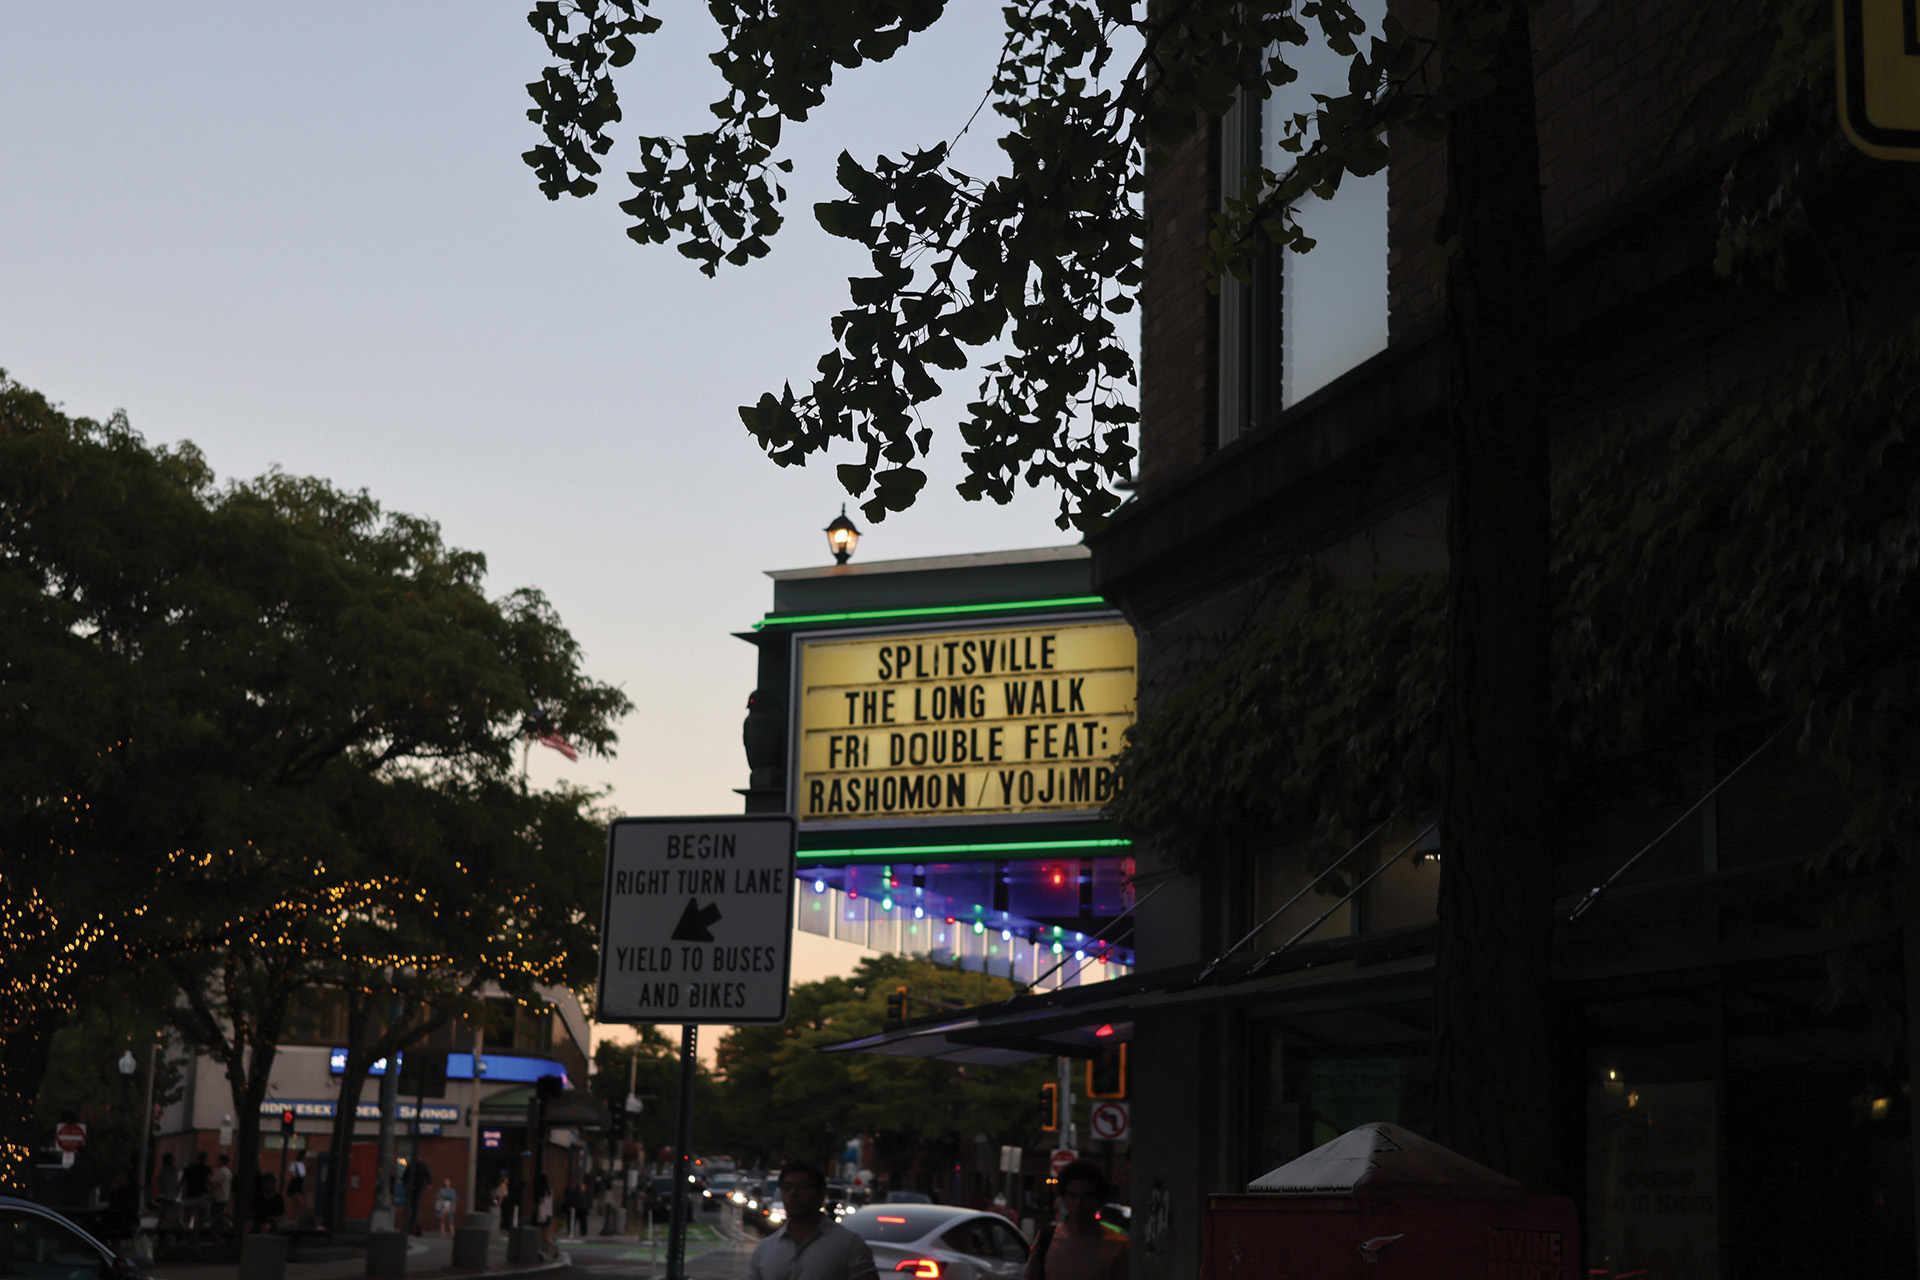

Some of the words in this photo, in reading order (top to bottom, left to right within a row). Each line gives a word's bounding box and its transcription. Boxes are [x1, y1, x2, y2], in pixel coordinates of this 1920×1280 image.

[878, 635, 1056, 680] SPLITSVILLE
[845, 690, 895, 724] THE
[915, 684, 986, 721] LONG
[1004, 677, 1086, 716] WALK
[829, 735, 869, 769] FRI
[890, 727, 1003, 766] DOUBLE
[1025, 722, 1108, 759] FEAT:
[810, 773, 966, 813] RASHOMON
[667, 834, 736, 859] BEGIN
[616, 870, 670, 895] RIGHT
[678, 869, 726, 894] TURN
[735, 868, 784, 894] LANE
[617, 947, 672, 972] YIELD
[682, 947, 703, 972] TO
[713, 947, 775, 972] BUSES
[639, 983, 679, 1008] AND
[689, 983, 747, 1008] BIKES
[399, 1105, 459, 1120] SAVINGS
[1488, 1226, 1562, 1263] DIVINE
